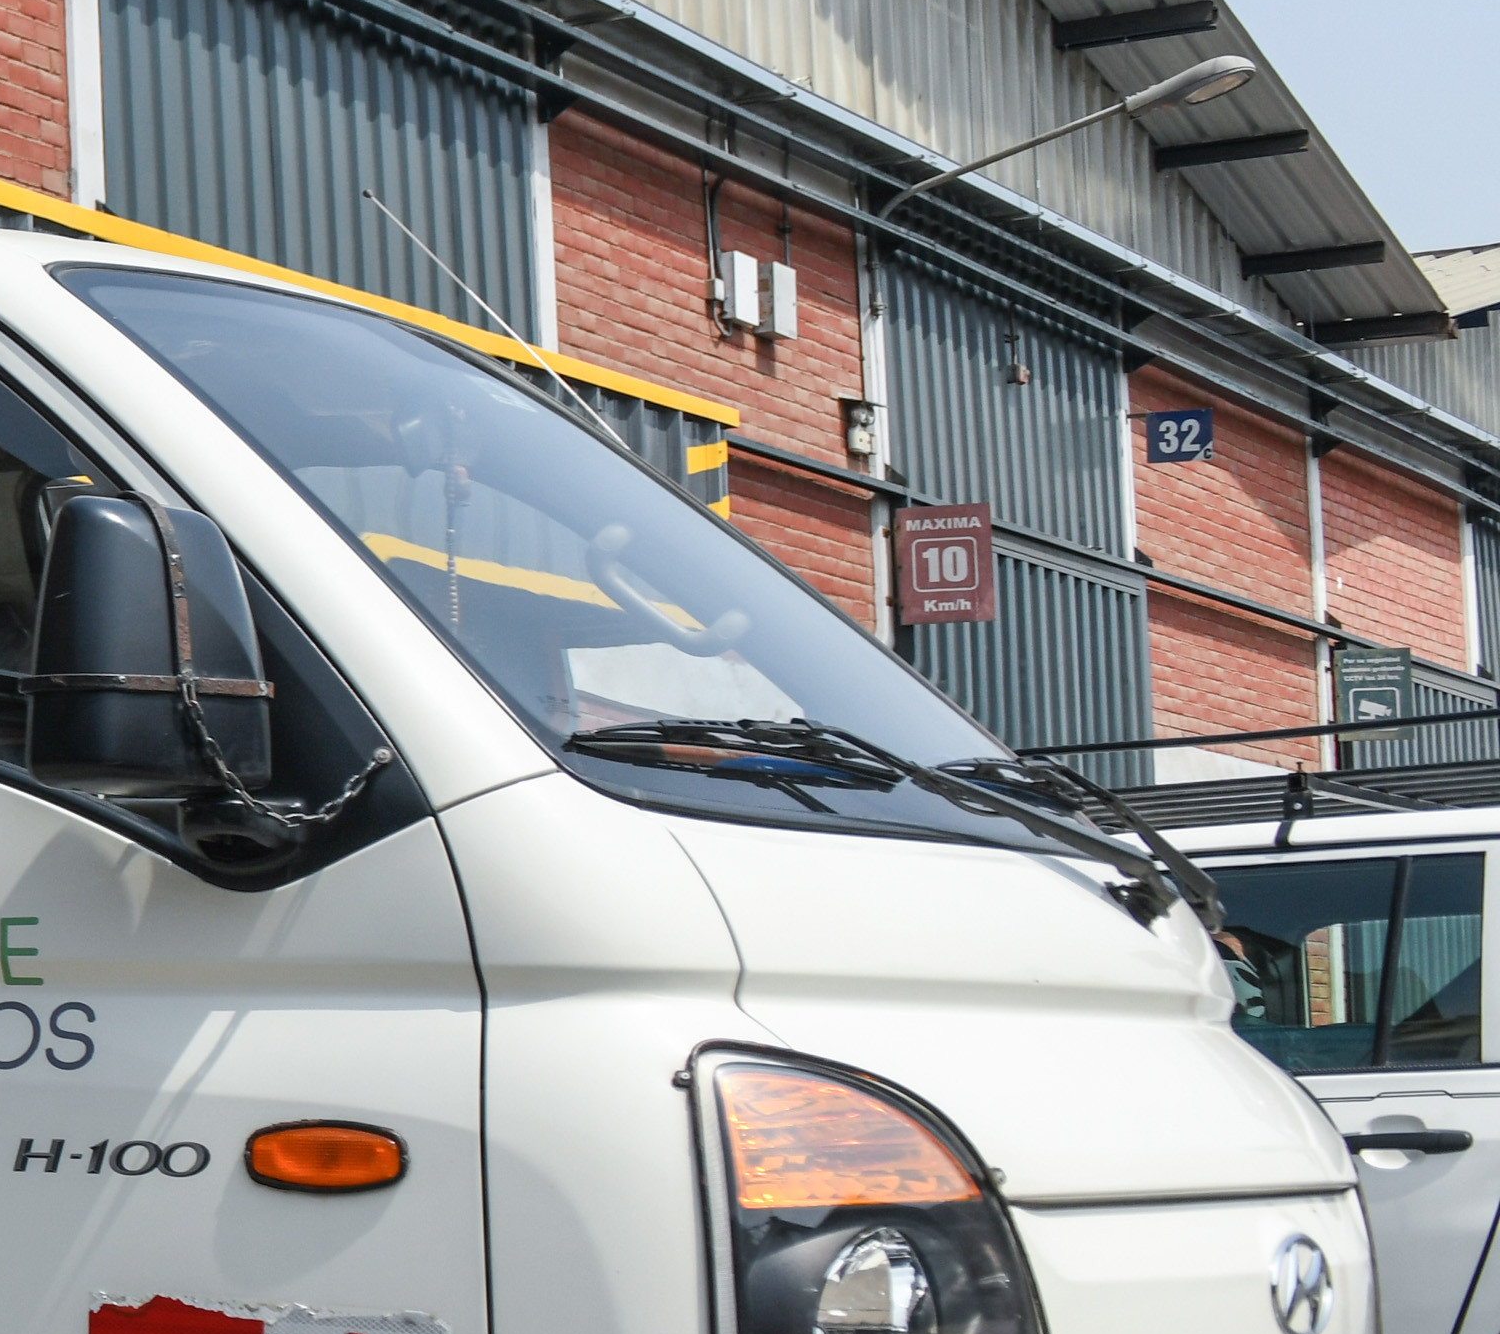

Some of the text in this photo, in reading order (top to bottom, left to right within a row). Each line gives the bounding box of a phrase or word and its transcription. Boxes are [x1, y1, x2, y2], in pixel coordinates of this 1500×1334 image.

[1158, 418, 1212, 459] 32 C
[905, 516, 982, 532] MAXIMA
[921, 545, 969, 583] 10
[924, 598, 972, 612] Km/h
[12, 1138, 211, 1178] H-100
